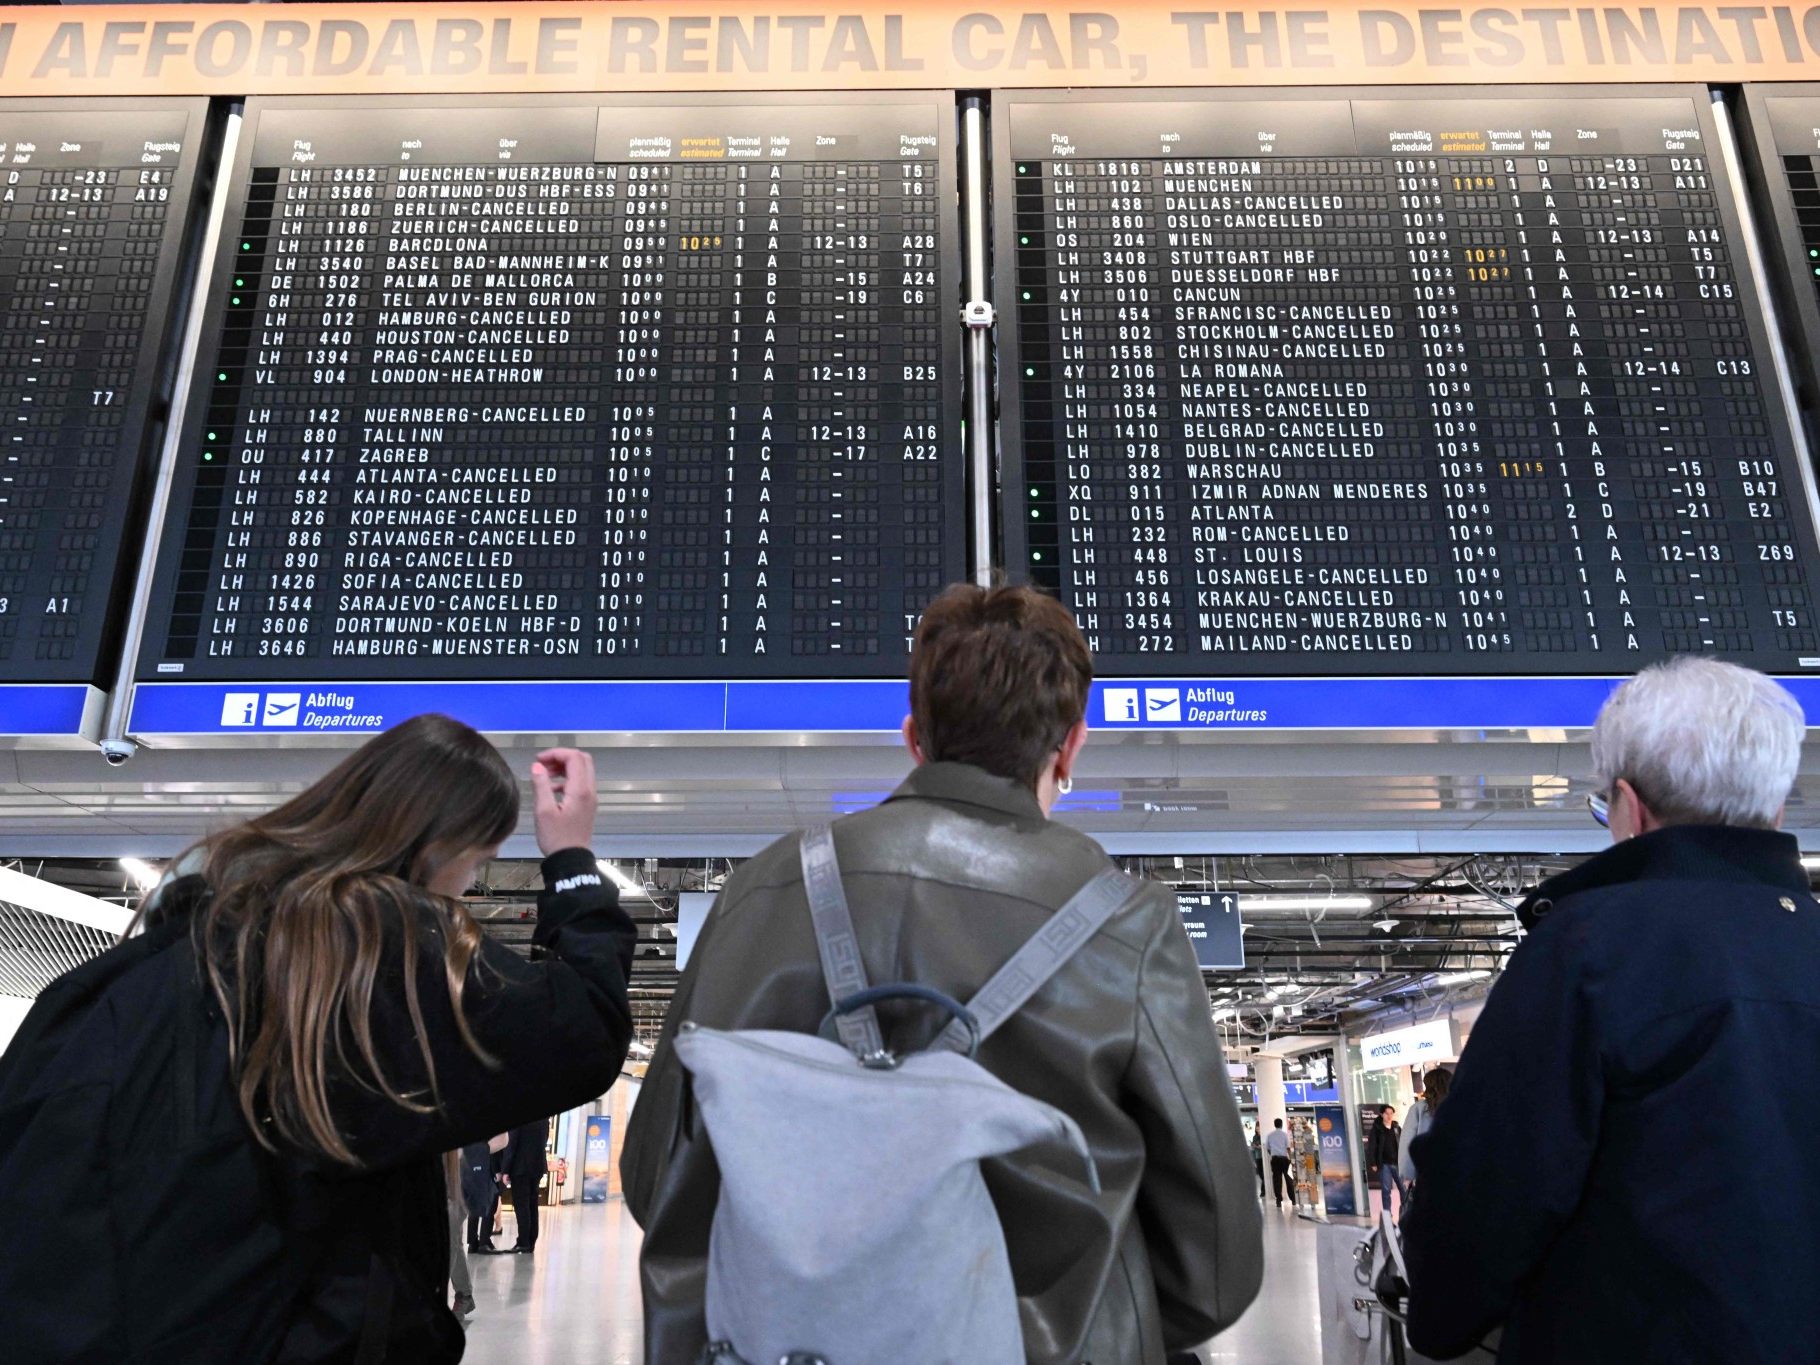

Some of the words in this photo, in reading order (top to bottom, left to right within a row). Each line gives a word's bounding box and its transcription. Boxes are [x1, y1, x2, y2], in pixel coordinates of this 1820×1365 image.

[31, 17, 583, 79] AFFORDABLE
[606, 14, 924, 75] RENTAL
[951, 11, 1148, 80] CAR,
[1170, 10, 1333, 69] THE
[816, 136, 836, 145] Zone
[900, 134, 936, 146] Flugsteig
[1258, 131, 1276, 141] über
[1487, 130, 1521, 139] Terminal
[1577, 129, 1598, 139] Zone
[1662, 129, 1700, 140] Flugsteig
[900, 146, 919, 155] Gate
[1052, 145, 1076, 156] Flight
[1392, 142, 1432, 152] scheduled
[1442, 142, 1486, 151] estimated
[1491, 141, 1525, 151] Terminal
[1534, 141, 1550, 150] Hall
[1665, 140, 1685, 150] Gate
[334, 169, 375, 181] 3452
[399, 167, 616, 180] MUENCHEN-WUERZBURG-N
[903, 165, 922, 177] T5
[1054, 164, 1072, 175] KL
[1099, 163, 1139, 175] 1816
[1164, 162, 1260, 174] AMSTERDAM
[1671, 159, 1701, 170] D21
[140, 171, 159, 183] E4
[1165, 180, 1251, 192] MUENCHEN
[1588, 177, 1639, 189] 12-13
[1676, 176, 1705, 188] A11
[52, 188, 102, 201] 12-13
[136, 188, 167, 200] A19
[397, 185, 526, 198] DORTMUND-DUS
[540, 184, 614, 197] HBF-ESS
[903, 183, 921, 194] T6
[395, 202, 569, 215] BERLIN-CANCELLED
[1166, 197, 1342, 210] DALLAS-CANCELLED
[392, 220, 578, 233] ZUERICH-CANCELLED
[1168, 215, 1322, 228] OSLO-CANCELLED
[816, 236, 866, 248] 12-13
[903, 236, 934, 248] A28
[1057, 234, 1077, 246] OS
[1114, 234, 1144, 246] 204
[1169, 233, 1212, 245] WIEN
[1688, 230, 1719, 242] A14
[387, 257, 439, 269] BASEL
[454, 256, 608, 269] BAD-MANNHEIM-K
[904, 254, 922, 266] T7
[1172, 251, 1269, 264] STUTTGART
[1284, 251, 1314, 263] HBF
[1691, 248, 1712, 260] T5
[272, 276, 292, 288] DE
[320, 275, 359, 288] 1502
[384, 275, 438, 287] PALMA
[452, 275, 471, 287] DE
[486, 274, 573, 287] MALLORCA
[903, 272, 934, 284] A24
[1105, 270, 1146, 283] 3506
[1172, 269, 1293, 282] DUESSELDORF
[1309, 269, 1339, 281] HBF
[1695, 266, 1714, 279] T7
[269, 295, 289, 307] 6H
[326, 294, 356, 306] 276
[383, 294, 411, 306] TEL
[427, 293, 516, 305] AVIV-BEN
[529, 292, 595, 305] GURION
[904, 290, 923, 303] C6
[1060, 289, 1079, 302] 4Y
[1117, 289, 1147, 301] 010
[1174, 288, 1240, 301] CANCUN
[1700, 285, 1732, 298] C15
[323, 313, 353, 326] 012
[379, 311, 570, 325] HAMBURG-CANCELLED
[1176, 306, 1390, 320] SFRANCISC-CANCELLED
[376, 330, 568, 344] HOUSTON-CANCELLED
[1177, 325, 1393, 339] STOCKHOLM-CANCELLED
[374, 349, 532, 363] PRAG-CANCELLED
[1179, 344, 1384, 358] CHISINAU-CANCELLED
[256, 371, 274, 383] VL
[314, 370, 344, 383] 904
[372, 369, 542, 383] LONDON-HEATHROW
[904, 367, 935, 380] B25
[1064, 365, 1084, 378] 4Y
[1111, 365, 1154, 378] 2106
[1181, 365, 1201, 377] LA
[1215, 364, 1283, 377] ROMANA
[1625, 362, 1680, 375] 12-14
[1717, 361, 1750, 374] C13
[1181, 383, 1366, 397] NEAPEL-CANCELLED
[94, 392, 113, 405] T7
[365, 408, 585, 422] NUERNBERG-CANCELLED
[1183, 403, 1368, 417] NANTES-CANCELLED
[364, 428, 442, 442] TALLINN
[904, 426, 936, 439] A16
[1116, 424, 1157, 438] 1410
[1185, 423, 1383, 437] BELGRAD-CANCELLED
[242, 449, 264, 463] OU
[302, 449, 333, 462] 417
[360, 449, 428, 462] ZAGREB
[904, 446, 936, 459] A22
[1186, 443, 1373, 457] DUBLIN-CANCELLED
[356, 468, 556, 483] ATLANTA-CANCELLED
[1069, 465, 1089, 479] LO
[1129, 465, 1160, 478] 382
[1187, 464, 1281, 478] WARSCHAU
[1739, 461, 1773, 475] B10
[295, 490, 327, 504] 582
[354, 489, 530, 504] KAIRO-CANCELLED
[1069, 485, 1091, 499] XQ
[1130, 485, 1160, 499] 911
[1193, 485, 1247, 499] IZMIR
[1262, 485, 1319, 498] ADNAN
[1334, 484, 1427, 498] MENDERES
[1743, 482, 1776, 496] B47
[351, 510, 576, 524] KOPENHAGE-CANCELLED
[1070, 507, 1090, 520] DL
[1132, 506, 1164, 520] 015
[1192, 506, 1273, 520] ATLANTA
[1749, 503, 1771, 517] E2
[349, 531, 575, 546] STAVANGER-CANCELLED
[1193, 526, 1348, 541] ROM-CANCELLED
[345, 552, 512, 567] RIGA-CANCELLED
[1195, 548, 1226, 563] ST.
[1245, 548, 1302, 562] LOUIS
[1662, 546, 1719, 560] 12-13
[1758, 545, 1793, 560] Z69
[343, 574, 522, 589] SOFIA-CANCELLED
[1197, 569, 1427, 584] LOSANGELE-CANCELLED
[46, 598, 68, 612] A1
[340, 595, 557, 611] SARAJEVO-CANCELLED
[1199, 591, 1393, 606] KRAKAU-CANCELLED
[263, 618, 308, 633] 3606
[336, 617, 506, 632] DORTMUND-KOELN
[521, 617, 580, 632] HBF-D
[1126, 614, 1171, 628] 3454
[1200, 612, 1446, 628] MUENCHEN-WUERZBURG-N
[1773, 611, 1796, 626] T5
[333, 639, 578, 655] HAMBURG-MUENSTER-OSN
[1202, 635, 1411, 650] MAILAND-CANCELLED
[306, 692, 354, 710] Abflug
[1186, 688, 1235, 705] Abflug
[303, 712, 383, 729] Departures
[1188, 707, 1267, 724] Departures
